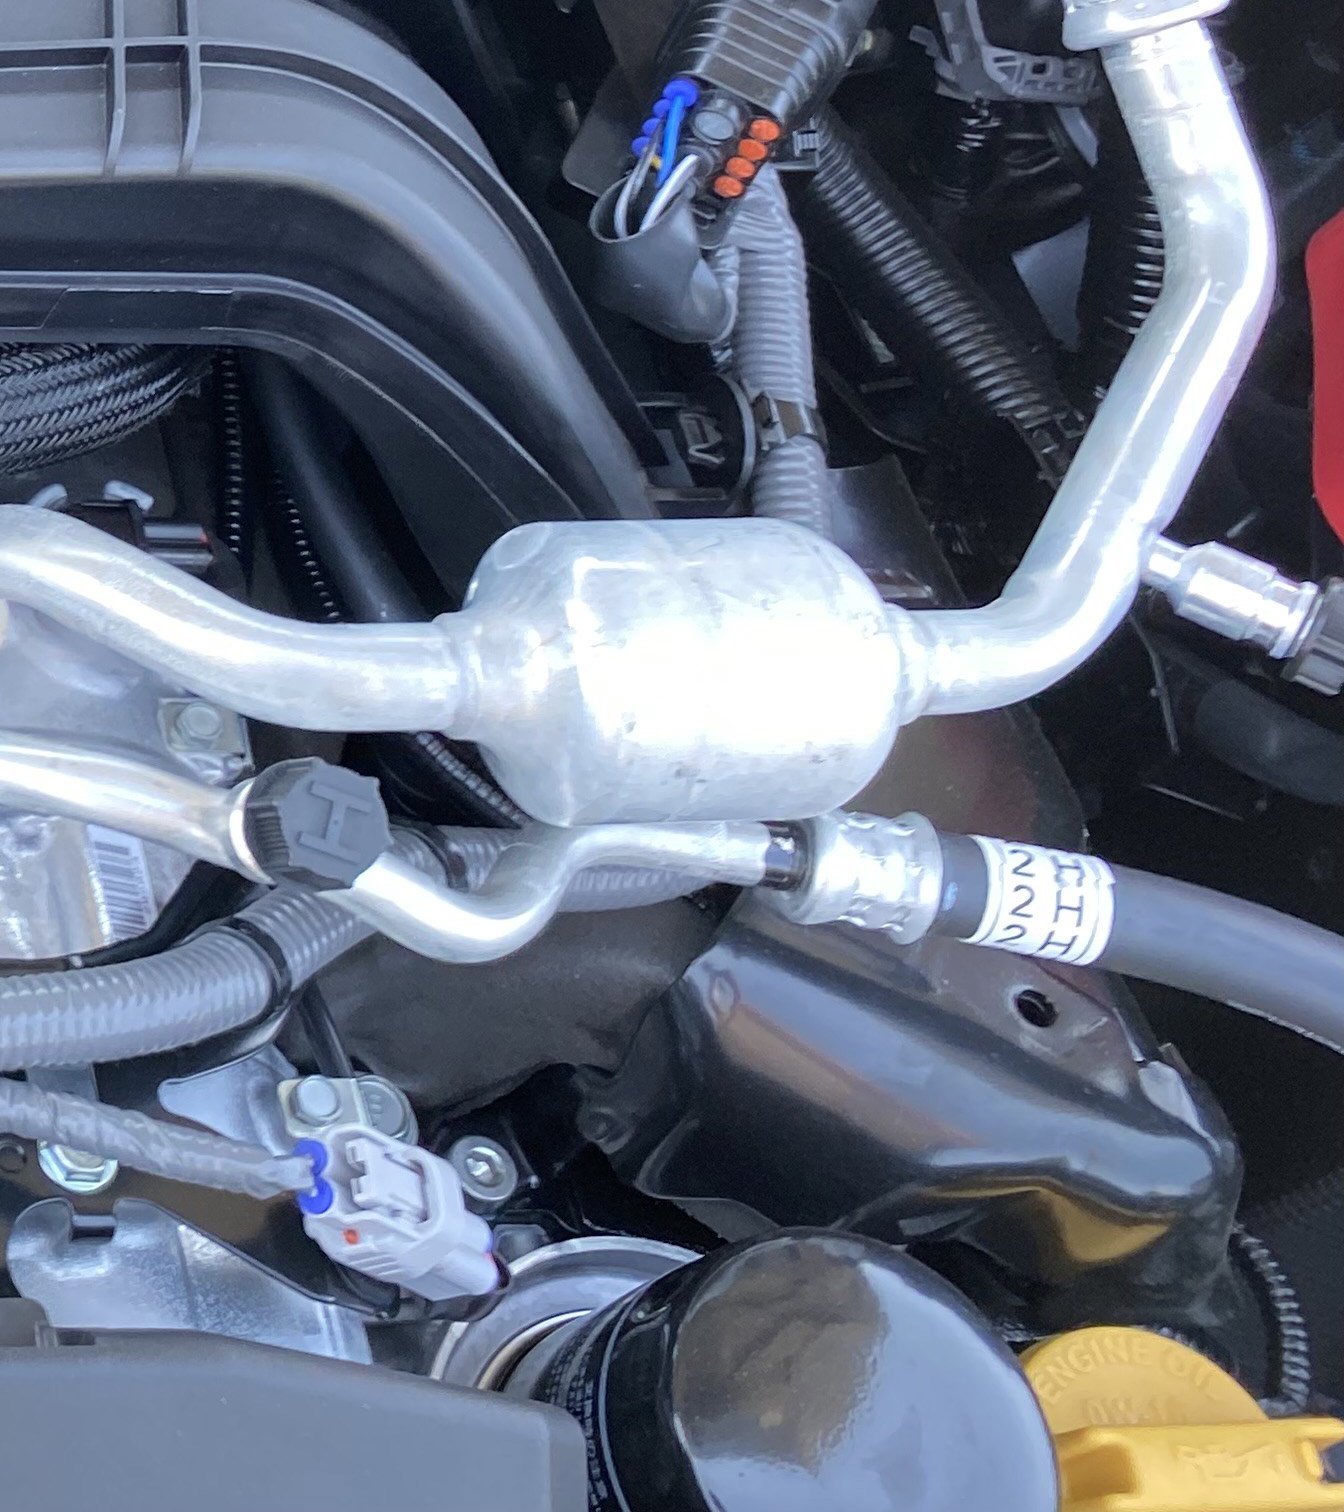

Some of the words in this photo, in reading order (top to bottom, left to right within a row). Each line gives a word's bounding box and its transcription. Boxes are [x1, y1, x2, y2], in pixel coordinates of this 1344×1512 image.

[1008, 849, 1036, 877] 2
[1009, 885, 1035, 918] 2
[1053, 890, 1084, 927] H
[1037, 930, 1078, 955] H
[1033, 1336, 1154, 1405] ENGINE
